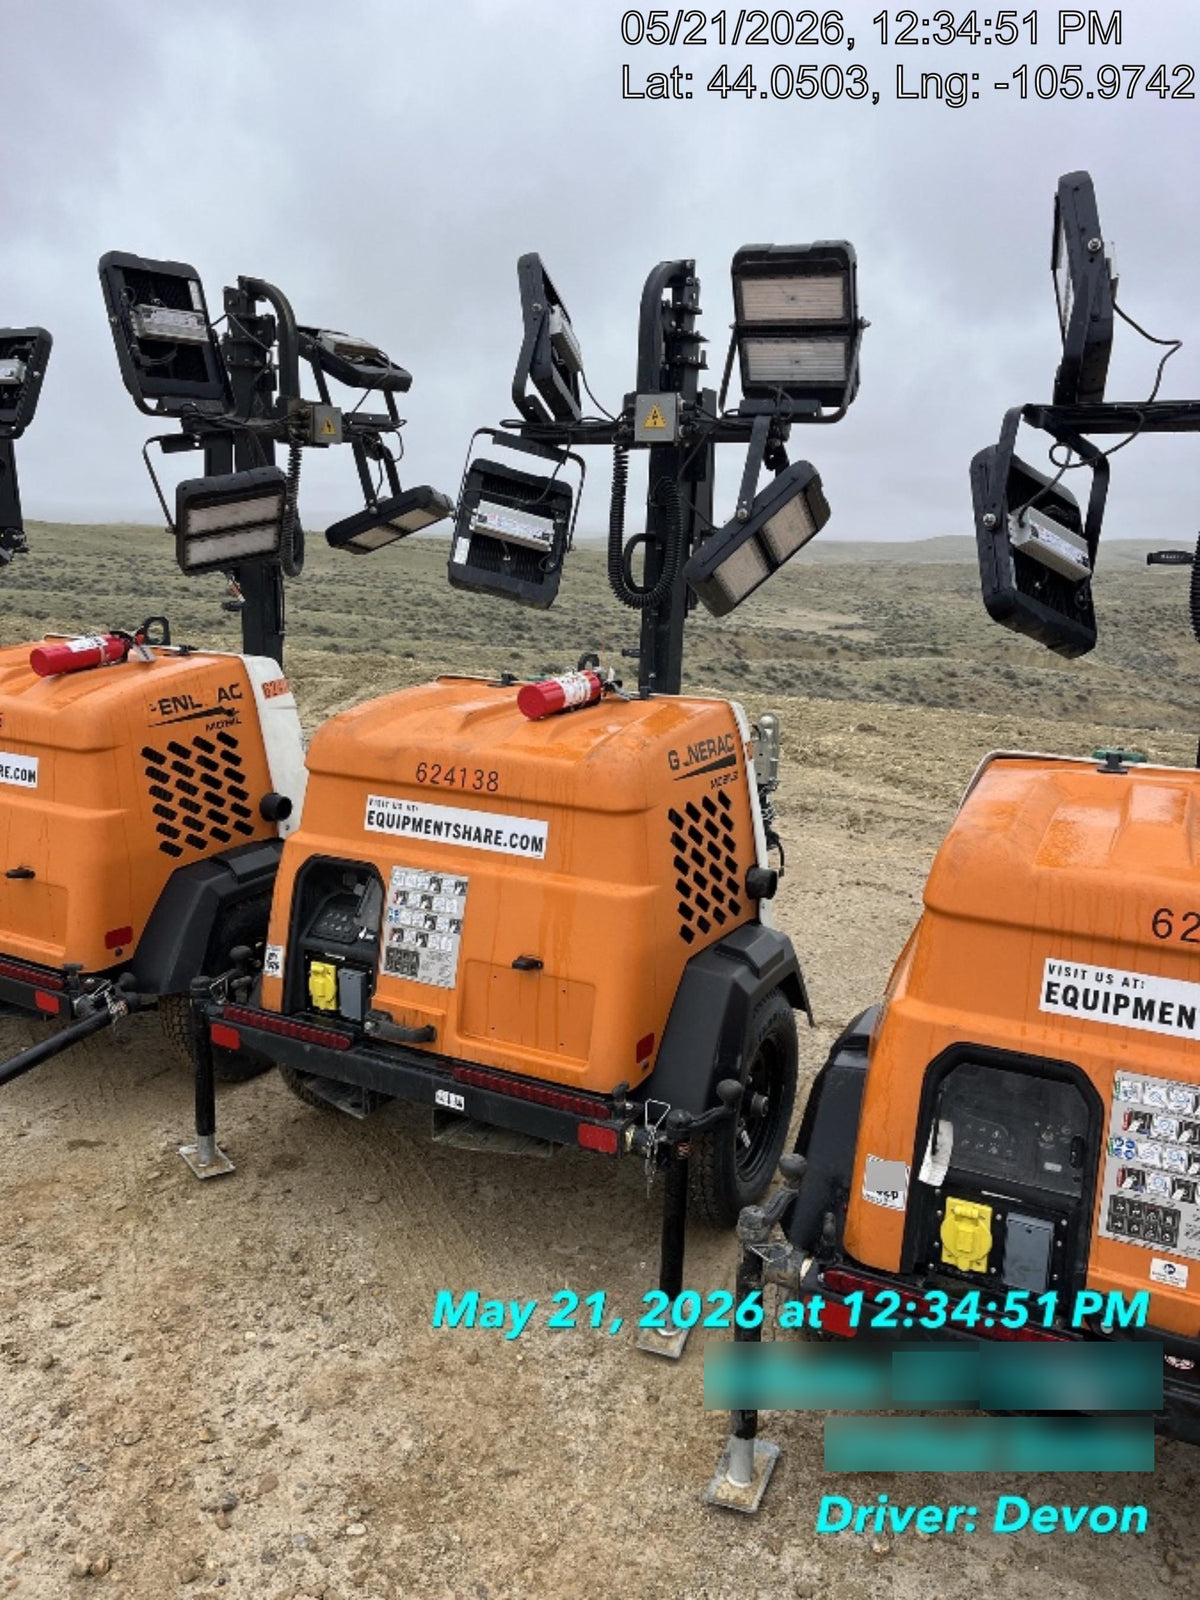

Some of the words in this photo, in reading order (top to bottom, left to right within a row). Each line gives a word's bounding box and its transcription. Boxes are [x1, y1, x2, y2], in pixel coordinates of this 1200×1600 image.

[667, 733, 736, 771] GNERAC
[415, 761, 499, 793] 624138
[367, 810, 545, 853] EQUIPMENTSHARE.COM
[1048, 963, 1088, 980] VISIT
[1095, 971, 1114, 985] US
[1121, 977, 1145, 990] AT:
